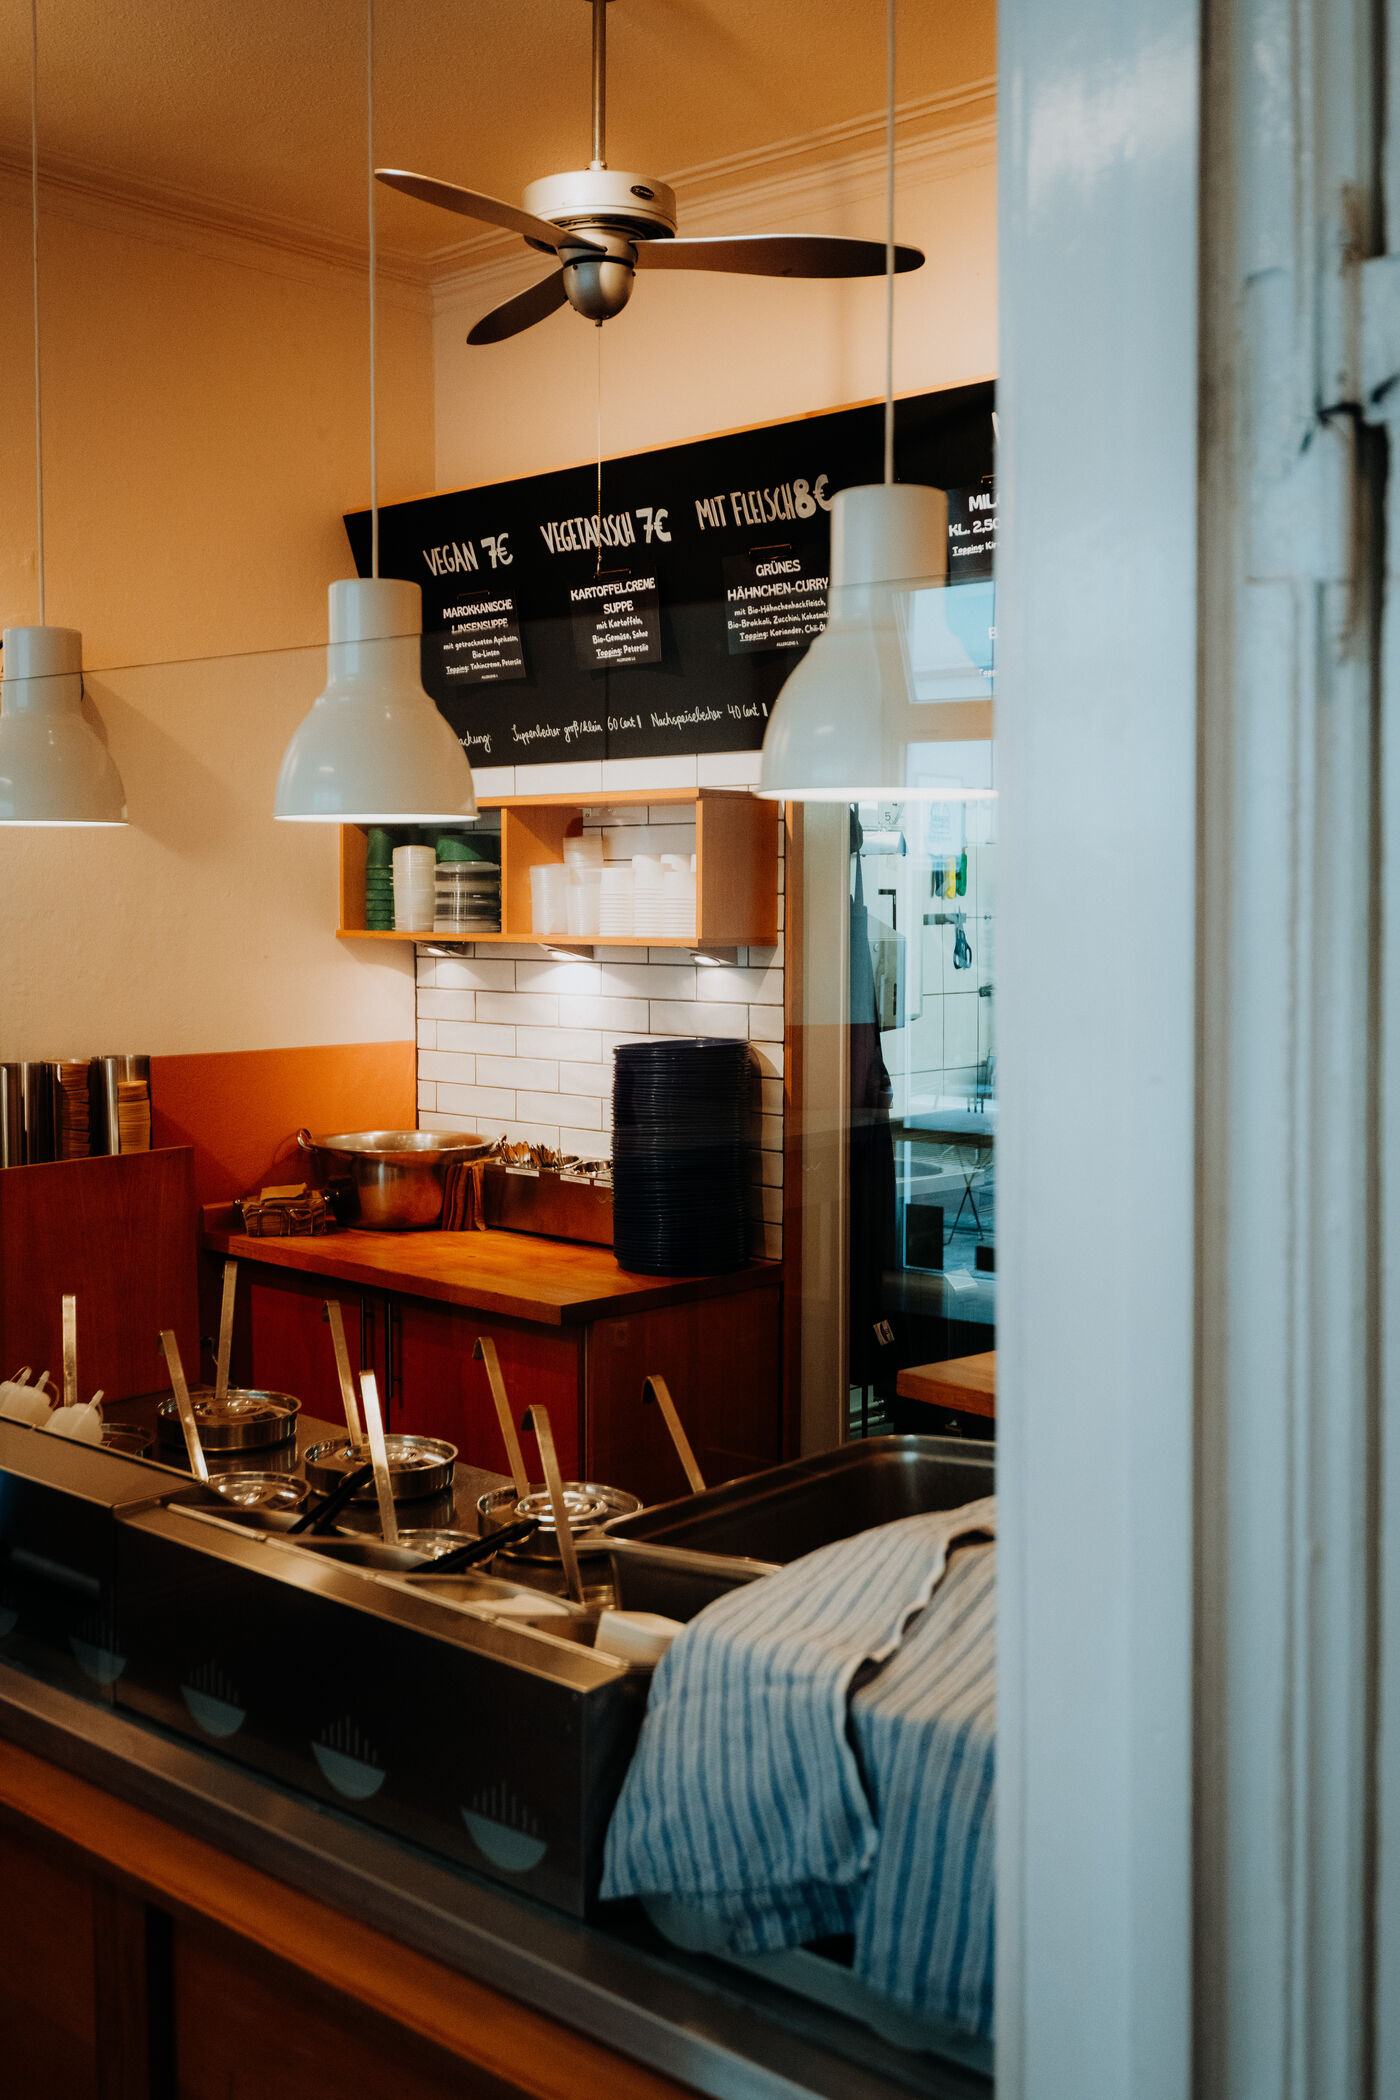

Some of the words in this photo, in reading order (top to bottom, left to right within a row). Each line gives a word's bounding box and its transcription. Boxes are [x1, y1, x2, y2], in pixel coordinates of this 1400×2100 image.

[695, 495, 727, 530] MIT
[730, 482, 797, 527] FLEISCH
[793, 473, 833, 519] 8€
[540, 511, 636, 554] VEGETARISCH
[635, 507, 672, 544] 7€
[948, 523, 971, 537] KL.
[422, 541, 479, 576] VEGAN
[480, 532, 514, 569] 7€
[952, 544, 984, 557] Topping:
[755, 559, 801, 577] GRÜNES
[570, 577, 656, 601] KARTOFFELCREME
[727, 577, 829, 601] HÄHNCHEN-CURRY
[442, 598, 513, 619] MAROKKANISCHE
[603, 600, 634, 615] SUPPE
[451, 617, 509, 634] LINSENSUPPE
[596, 620, 608, 630] mit
[608, 615, 643, 629] Kartoffeln,
[727, 618, 772, 630] Bio-Brokkoli,
[772, 613, 801, 625] Zucchini,
[592, 633, 632, 645] Bio-Gemüse,
[631, 629, 649, 640] Sahne
[739, 631, 769, 643] Topping:
[769, 626, 804, 638] Koriander,
[443, 642, 454, 651] mit
[596, 647, 622, 659] Topping:
[511, 723, 561, 746] Suppenbecher
[607, 716, 619, 731] 60
[619, 716, 637, 729] Cent
[650, 705, 723, 730] Nachspeisebecher
[727, 703, 741, 719] 40
[741, 702, 760, 717] Cent
